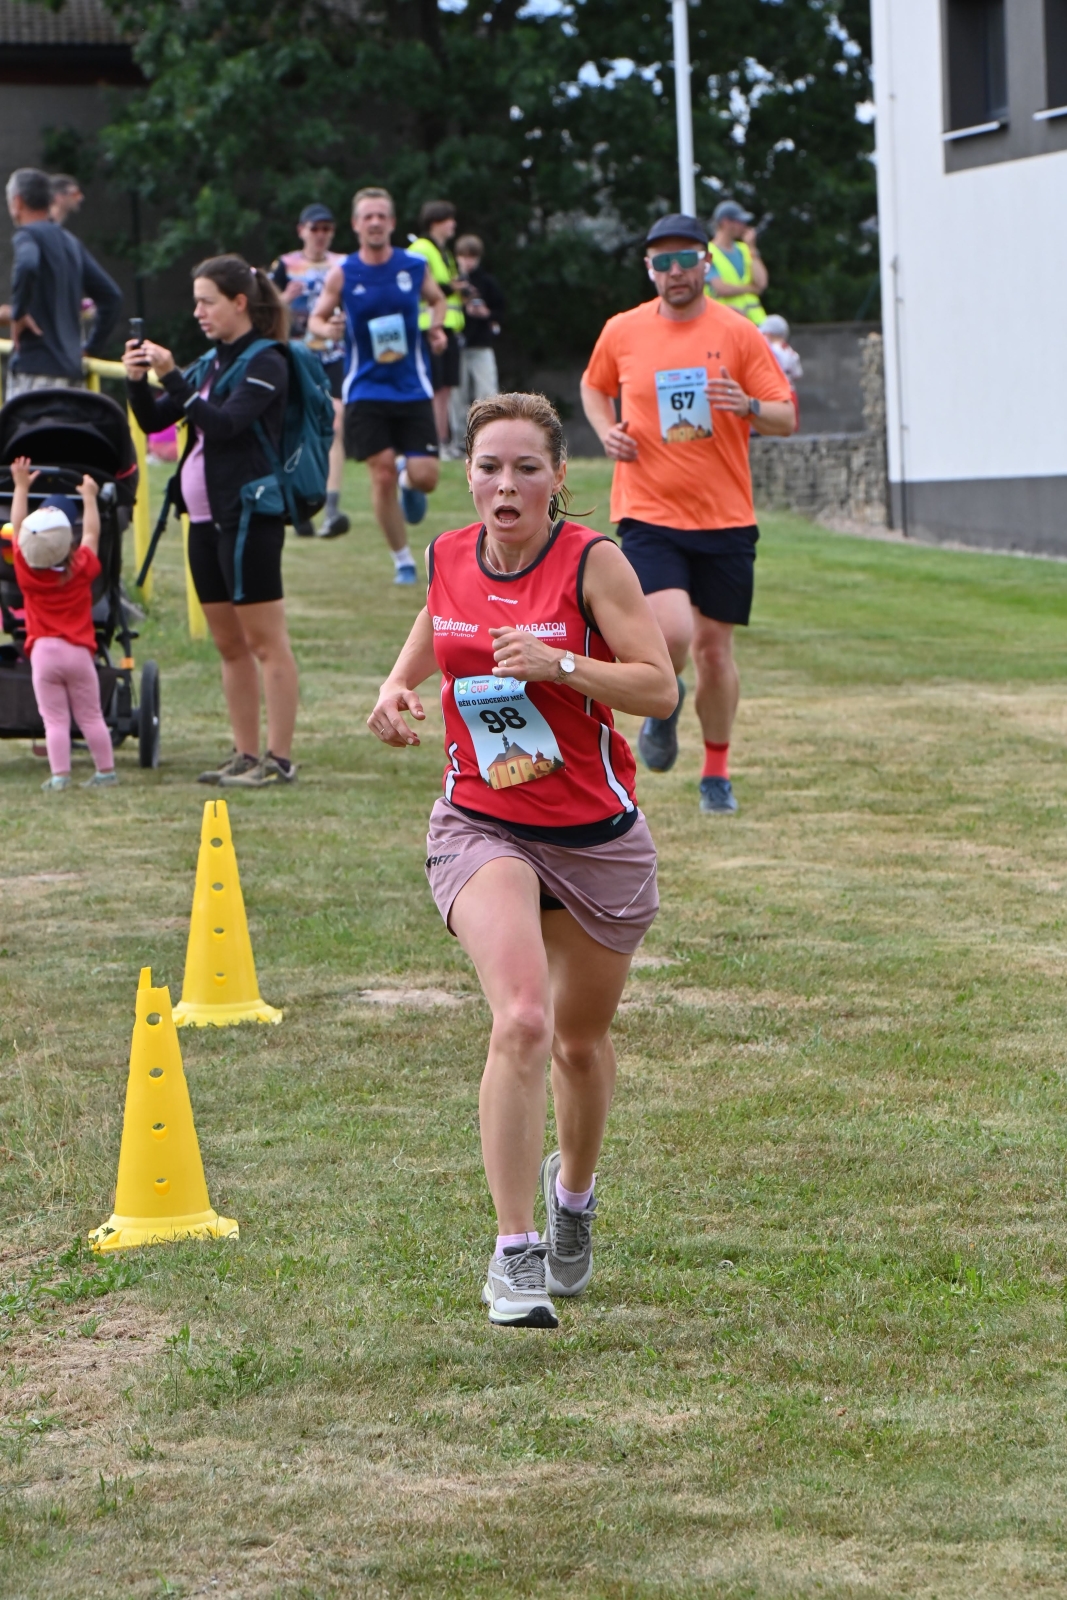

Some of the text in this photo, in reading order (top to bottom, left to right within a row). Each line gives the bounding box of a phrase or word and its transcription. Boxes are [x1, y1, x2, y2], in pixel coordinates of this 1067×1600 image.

[670, 391, 695, 411] 67
[515, 622, 566, 632] MARATON
[470, 684, 489, 694] CUP
[458, 698, 471, 707] BĚH
[477, 695, 510, 705] LUDGERŮV
[510, 693, 525, 702] MEČ
[479, 707, 527, 734] 98
